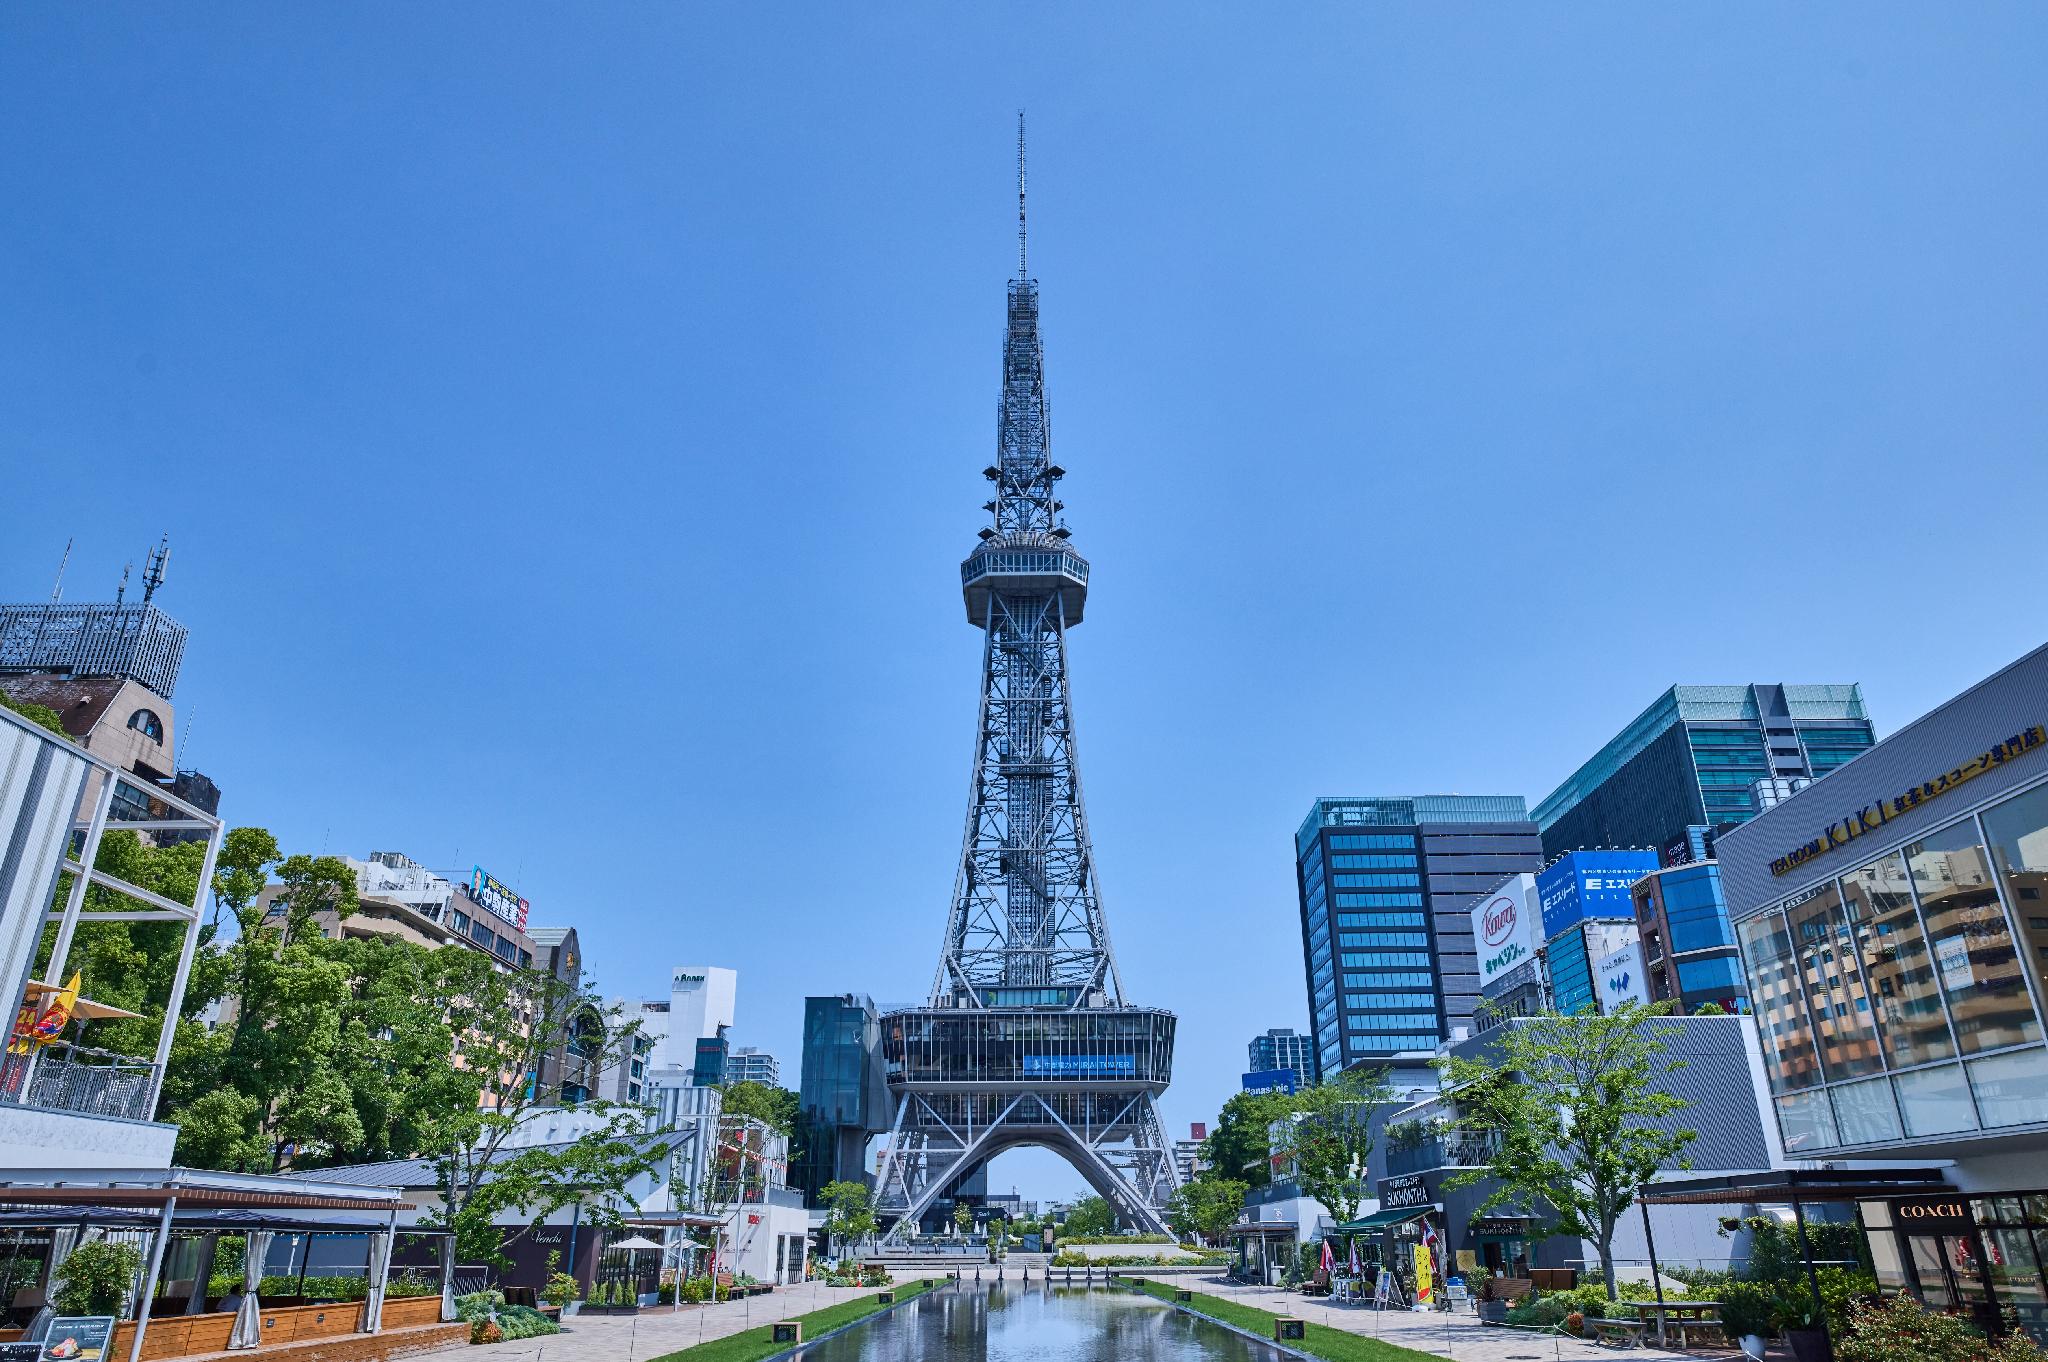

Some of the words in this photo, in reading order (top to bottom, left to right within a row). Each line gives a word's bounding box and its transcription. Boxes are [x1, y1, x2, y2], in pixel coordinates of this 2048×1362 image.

[1787, 838, 1820, 864] ROOM
[1824, 799, 1888, 849] KIKI
[1485, 904, 1515, 940] Kowa
[1244, 1084, 1289, 1095] Panasnic
[1387, 1187, 1428, 1206] SUKHONTHA
[1900, 1204, 1964, 1218] COACH
[531, 1230, 563, 1244] Venchi
